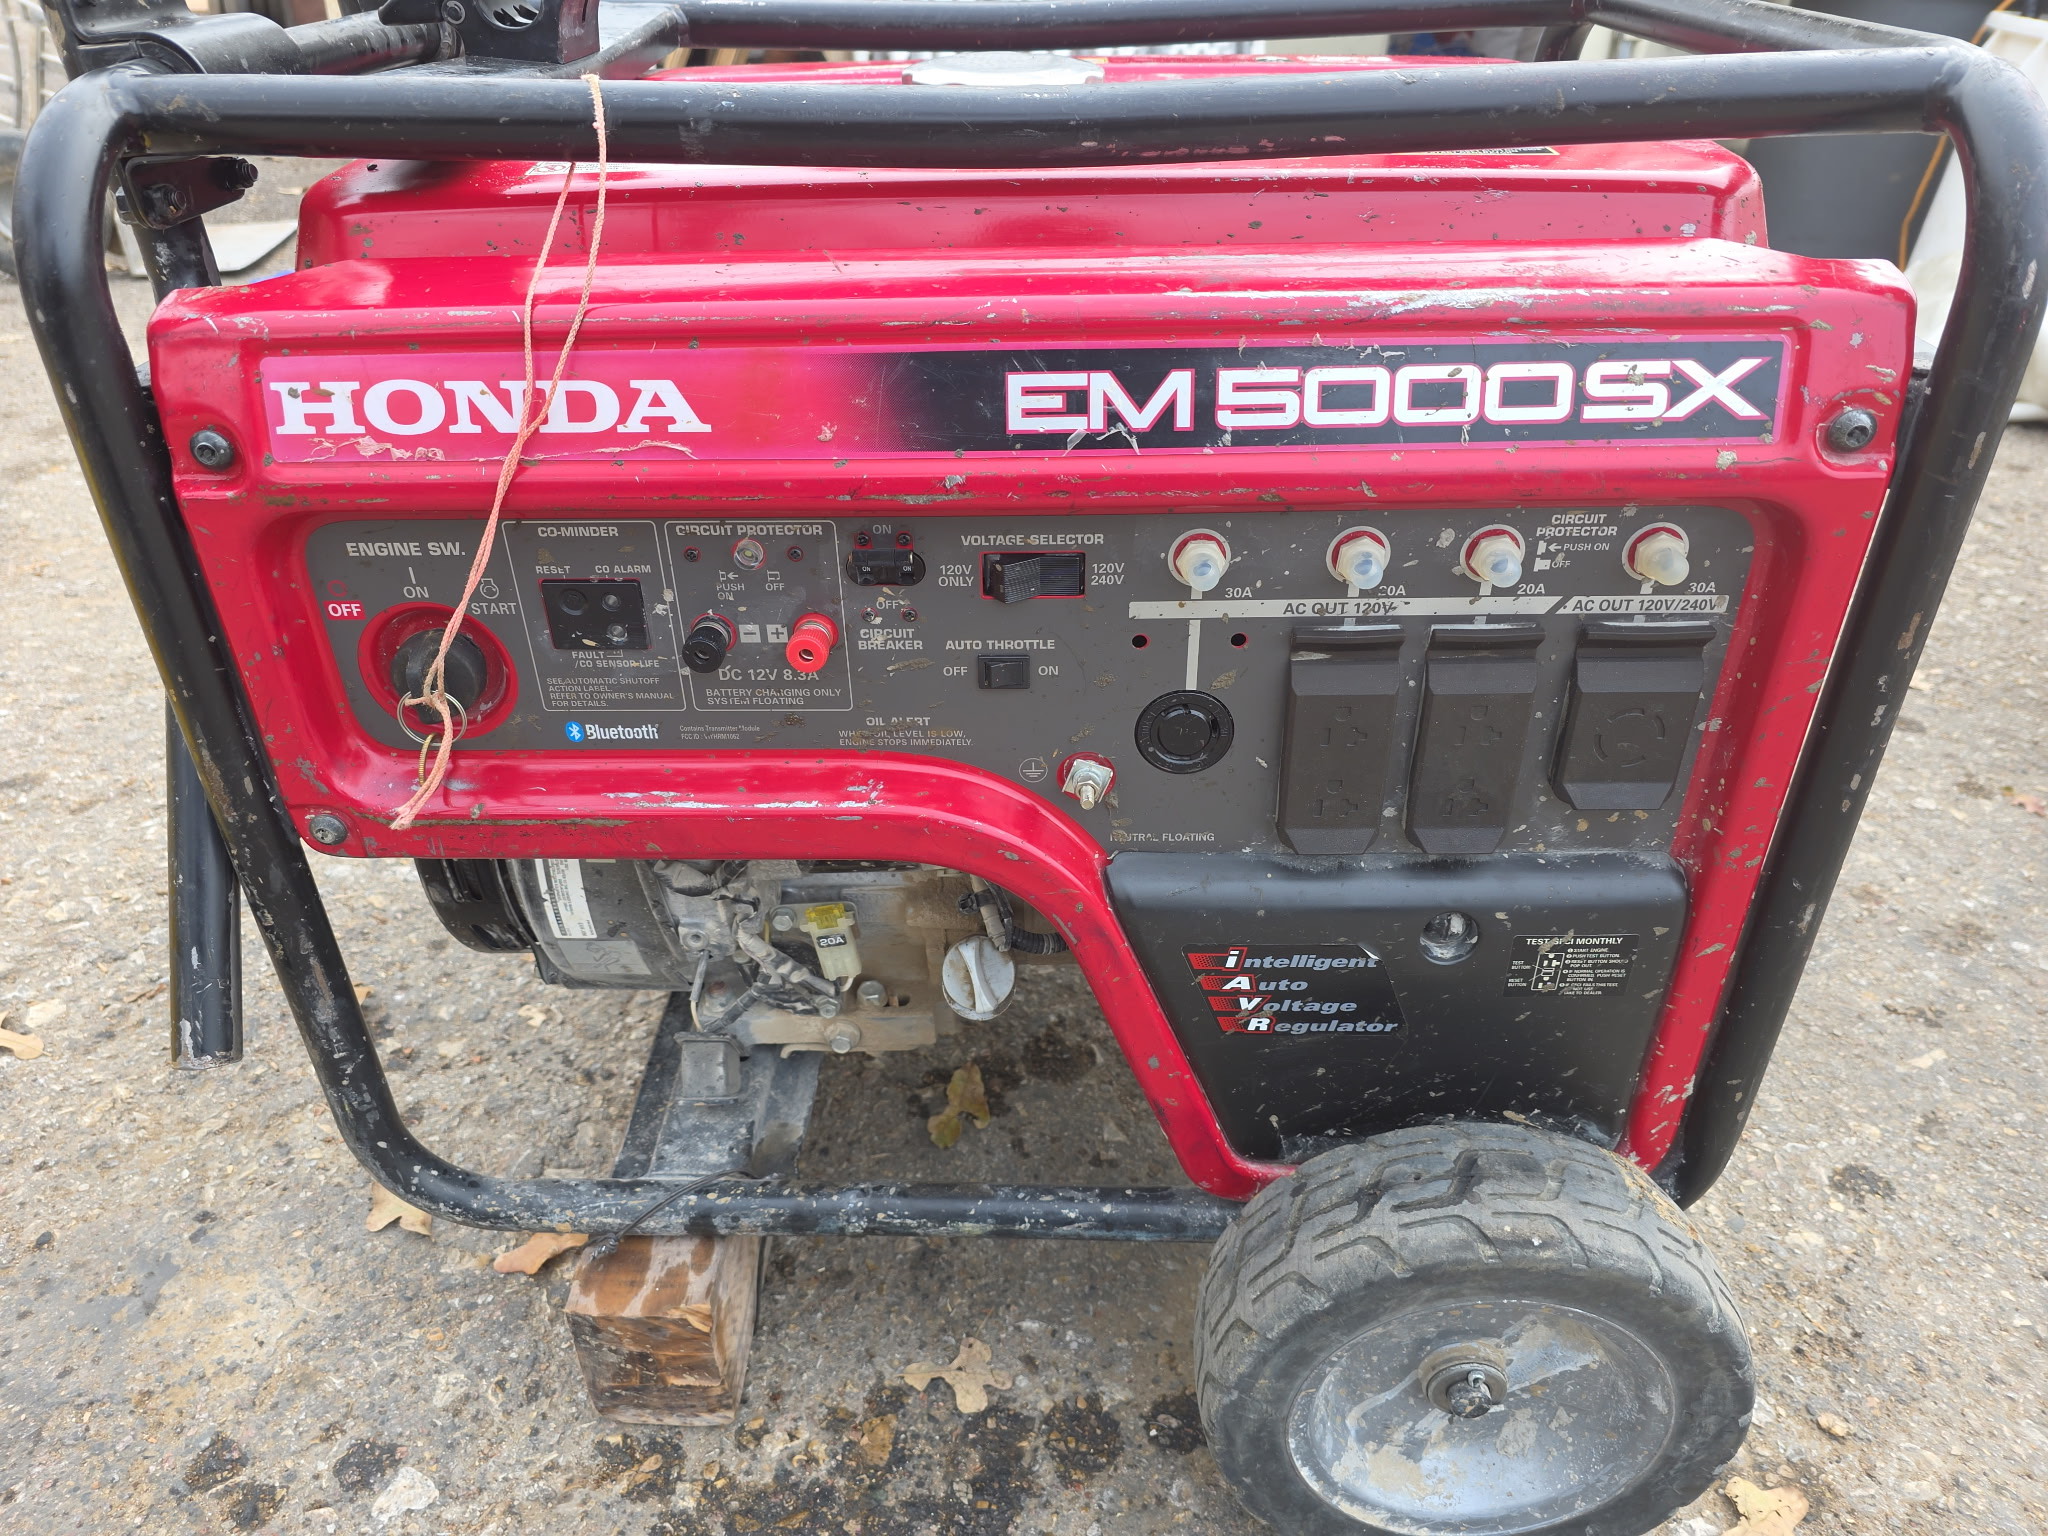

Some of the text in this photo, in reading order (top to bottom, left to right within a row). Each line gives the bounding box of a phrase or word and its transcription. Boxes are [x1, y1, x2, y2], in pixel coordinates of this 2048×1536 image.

[270, 379, 712, 435] HONDA
[1551, 514, 1607, 524] CIRCUIT
[537, 526, 619, 537] CO-MINDER
[676, 525, 823, 536] CIRCUIT PROTECTOR
[872, 524, 892, 534] ON
[1536, 526, 1618, 537] PROTECTOR
[960, 534, 1104, 546] VOLTAGE SELECTOR
[346, 542, 466, 556] ENGINE SW.
[1564, 543, 1592, 551] PUSH
[595, 565, 651, 573] CO ALARM
[1092, 563, 1125, 573] 120V
[1552, 560, 1571, 568] OFF
[536, 566, 570, 574] RESET
[940, 565, 972, 575] 120V
[938, 576, 974, 587] ONLY
[1091, 575, 1125, 585] 240V
[403, 586, 429, 598] ON
[716, 583, 745, 591] PUSH
[765, 583, 785, 591] OFF
[1517, 584, 1545, 595] 20A
[1687, 582, 1716, 593] 30A
[718, 592, 734, 600] ON
[1225, 587, 1252, 598] 30A
[471, 602, 516, 615] START
[876, 600, 899, 609] OFF
[1283, 602, 1394, 615] AC OUT 120V
[1572, 598, 1718, 611] AC OUT 120V/240V
[328, 604, 361, 616] OFF
[860, 628, 914, 638] CIRCUIT
[858, 640, 923, 650] BREAKER
[946, 640, 1055, 650] AUTO THROTTLE
[597, 660, 635, 668] SENSOR
[718, 668, 819, 680] DC 12V 8.3A
[943, 667, 968, 676] OFF
[1038, 666, 1058, 676] ON
[866, 717, 886, 726] OIL
[1110, 833, 1214, 841] UTRAL FLOATING
[820, 937, 844, 946] 20A
[1222, 976, 1308, 990] Auto
[1239, 997, 1357, 1014] Voltage
[1247, 1018, 1398, 1034] Regulator
